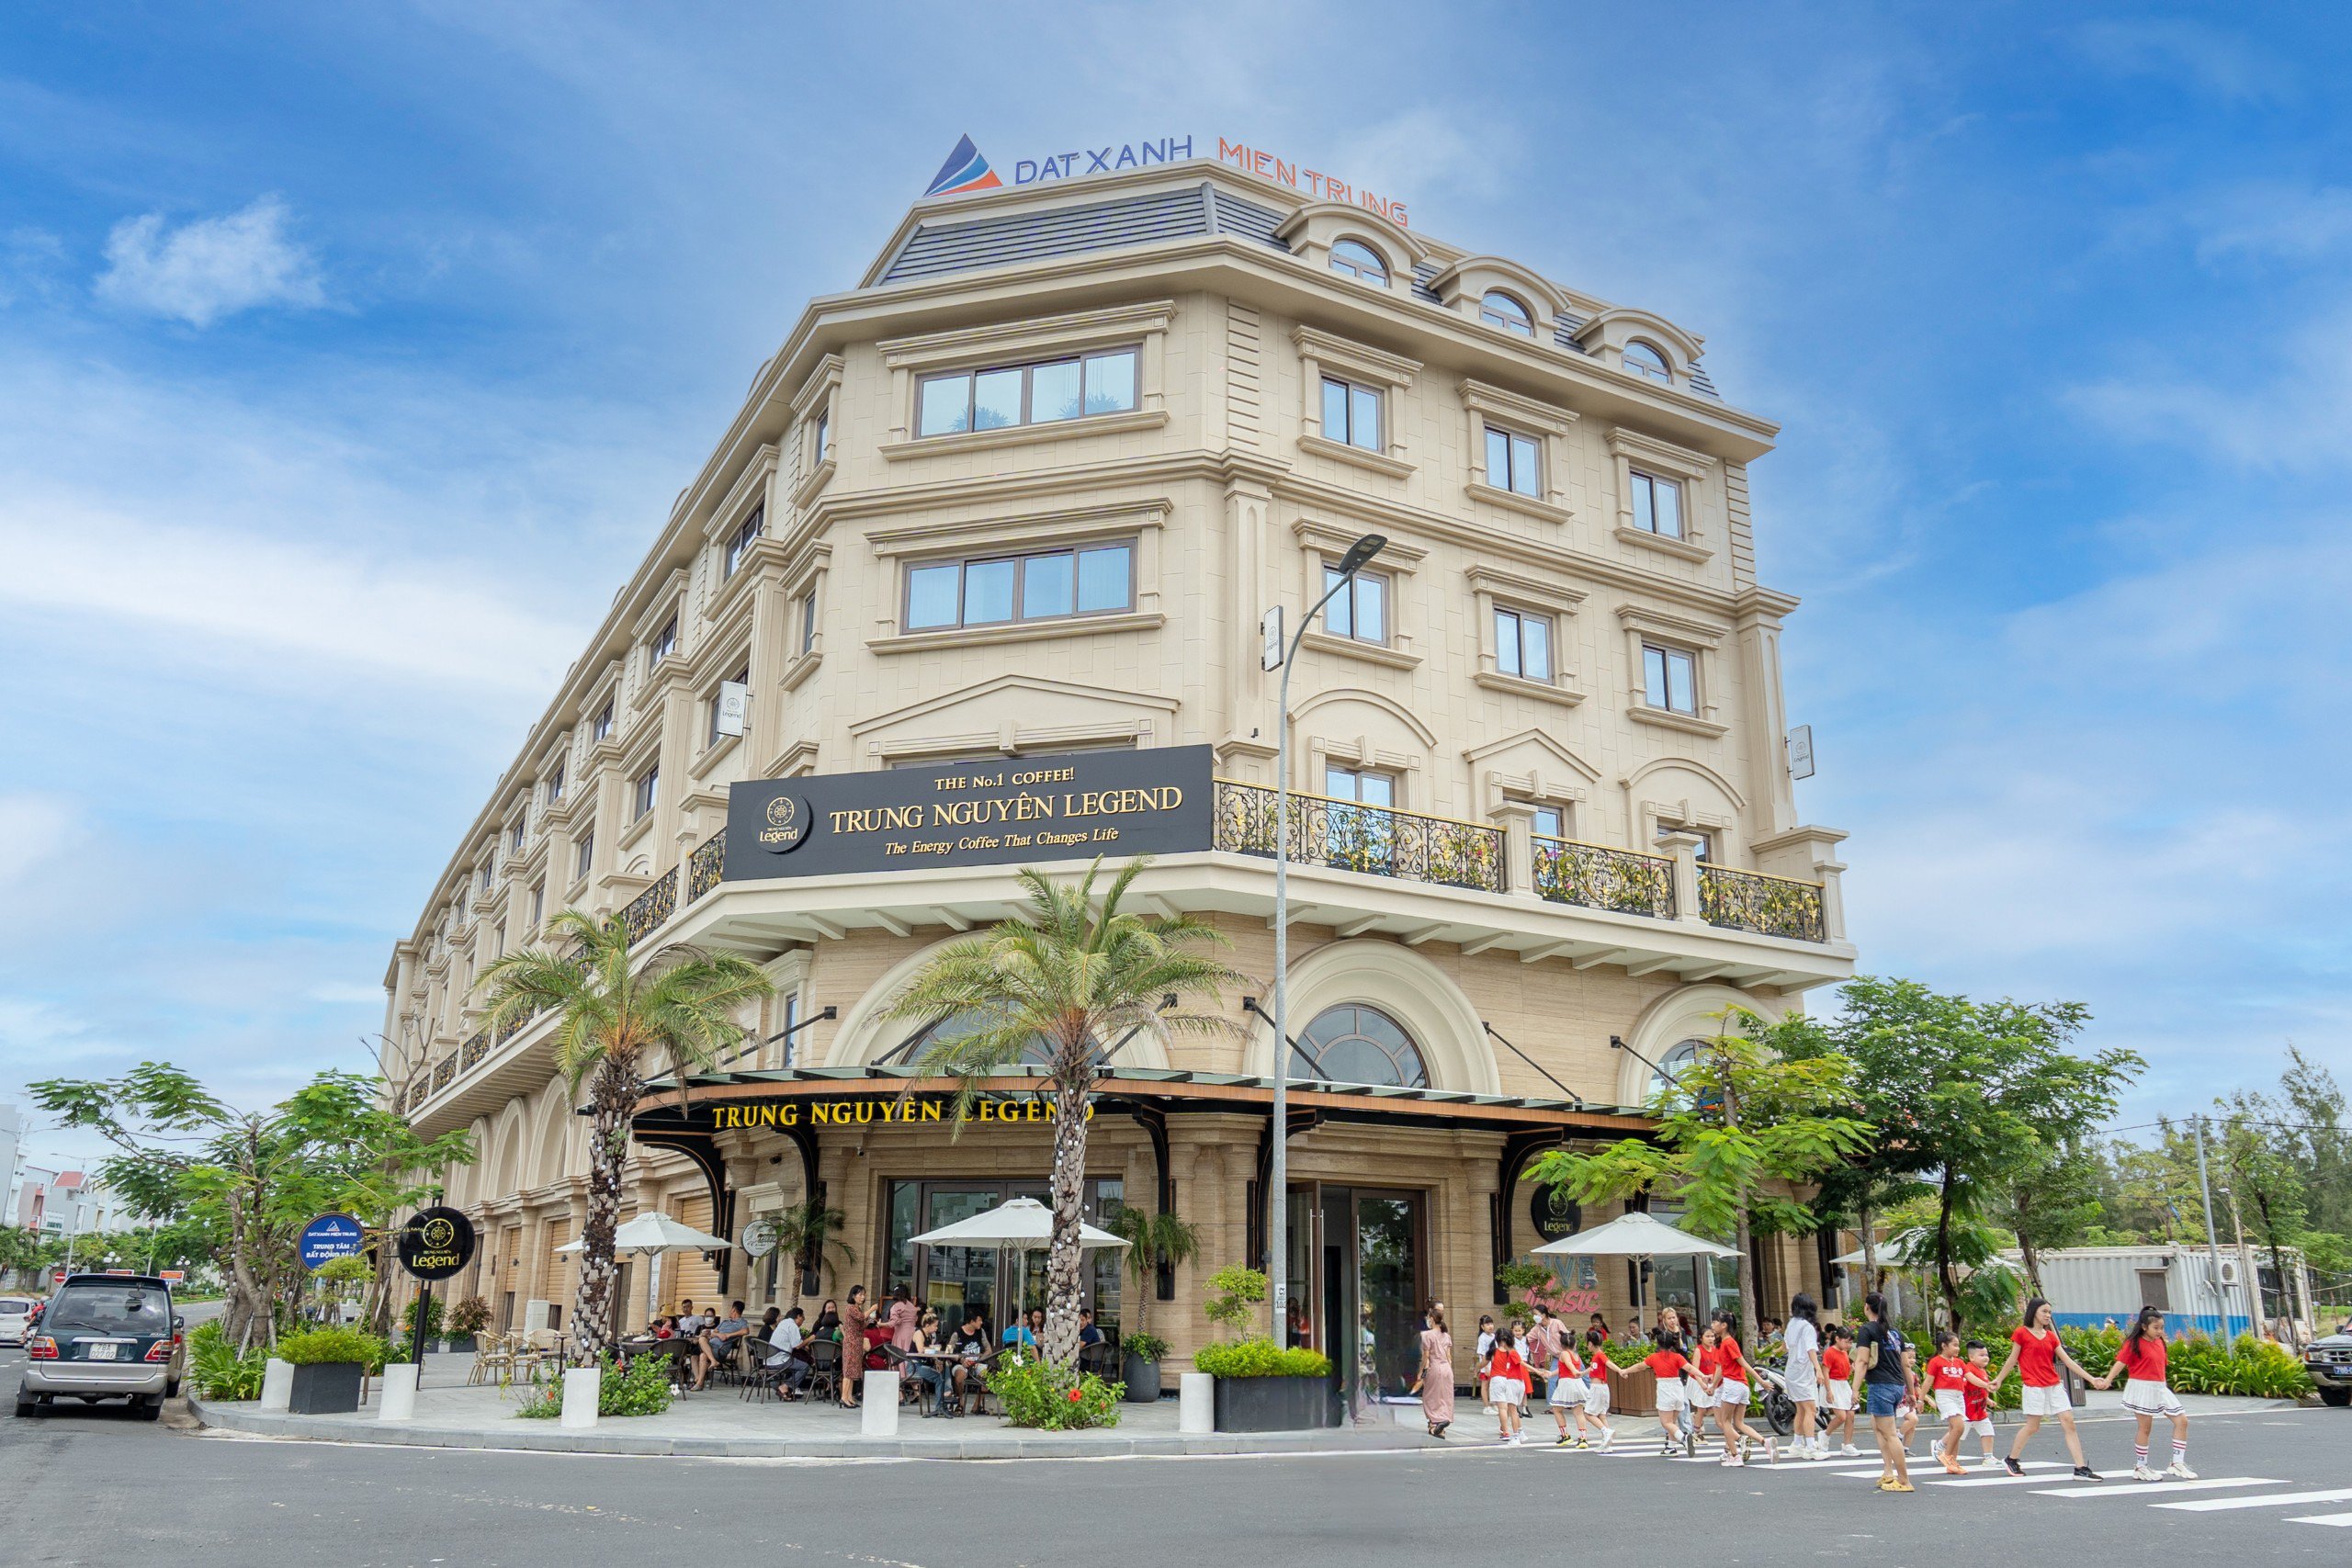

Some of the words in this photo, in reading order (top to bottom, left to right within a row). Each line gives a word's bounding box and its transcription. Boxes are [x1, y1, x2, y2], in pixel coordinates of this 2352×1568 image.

[934, 777, 967, 791] THE
[972, 773, 1005, 788] No.1
[1012, 766, 1075, 785] COFFEE!
[830, 805, 924, 834] TRUNG
[932, 792, 1057, 827] NGUYÊN
[1063, 786, 1183, 818] LEGEND
[760, 828, 798, 843] Legend
[885, 842, 907, 855] The
[911, 840, 953, 855] Energy
[958, 837, 1000, 851] Coffee
[1004, 833, 1032, 848] That
[1036, 830, 1088, 846] Changes
[1092, 827, 1120, 841] Life
[712, 1104, 799, 1129] TRUNG
[810, 1096, 942, 1125] NGUYÊN
[1544, 1221, 1574, 1234] Legend
[412, 1252, 460, 1269] Legend
[1522, 1254, 1597, 1290] VE
